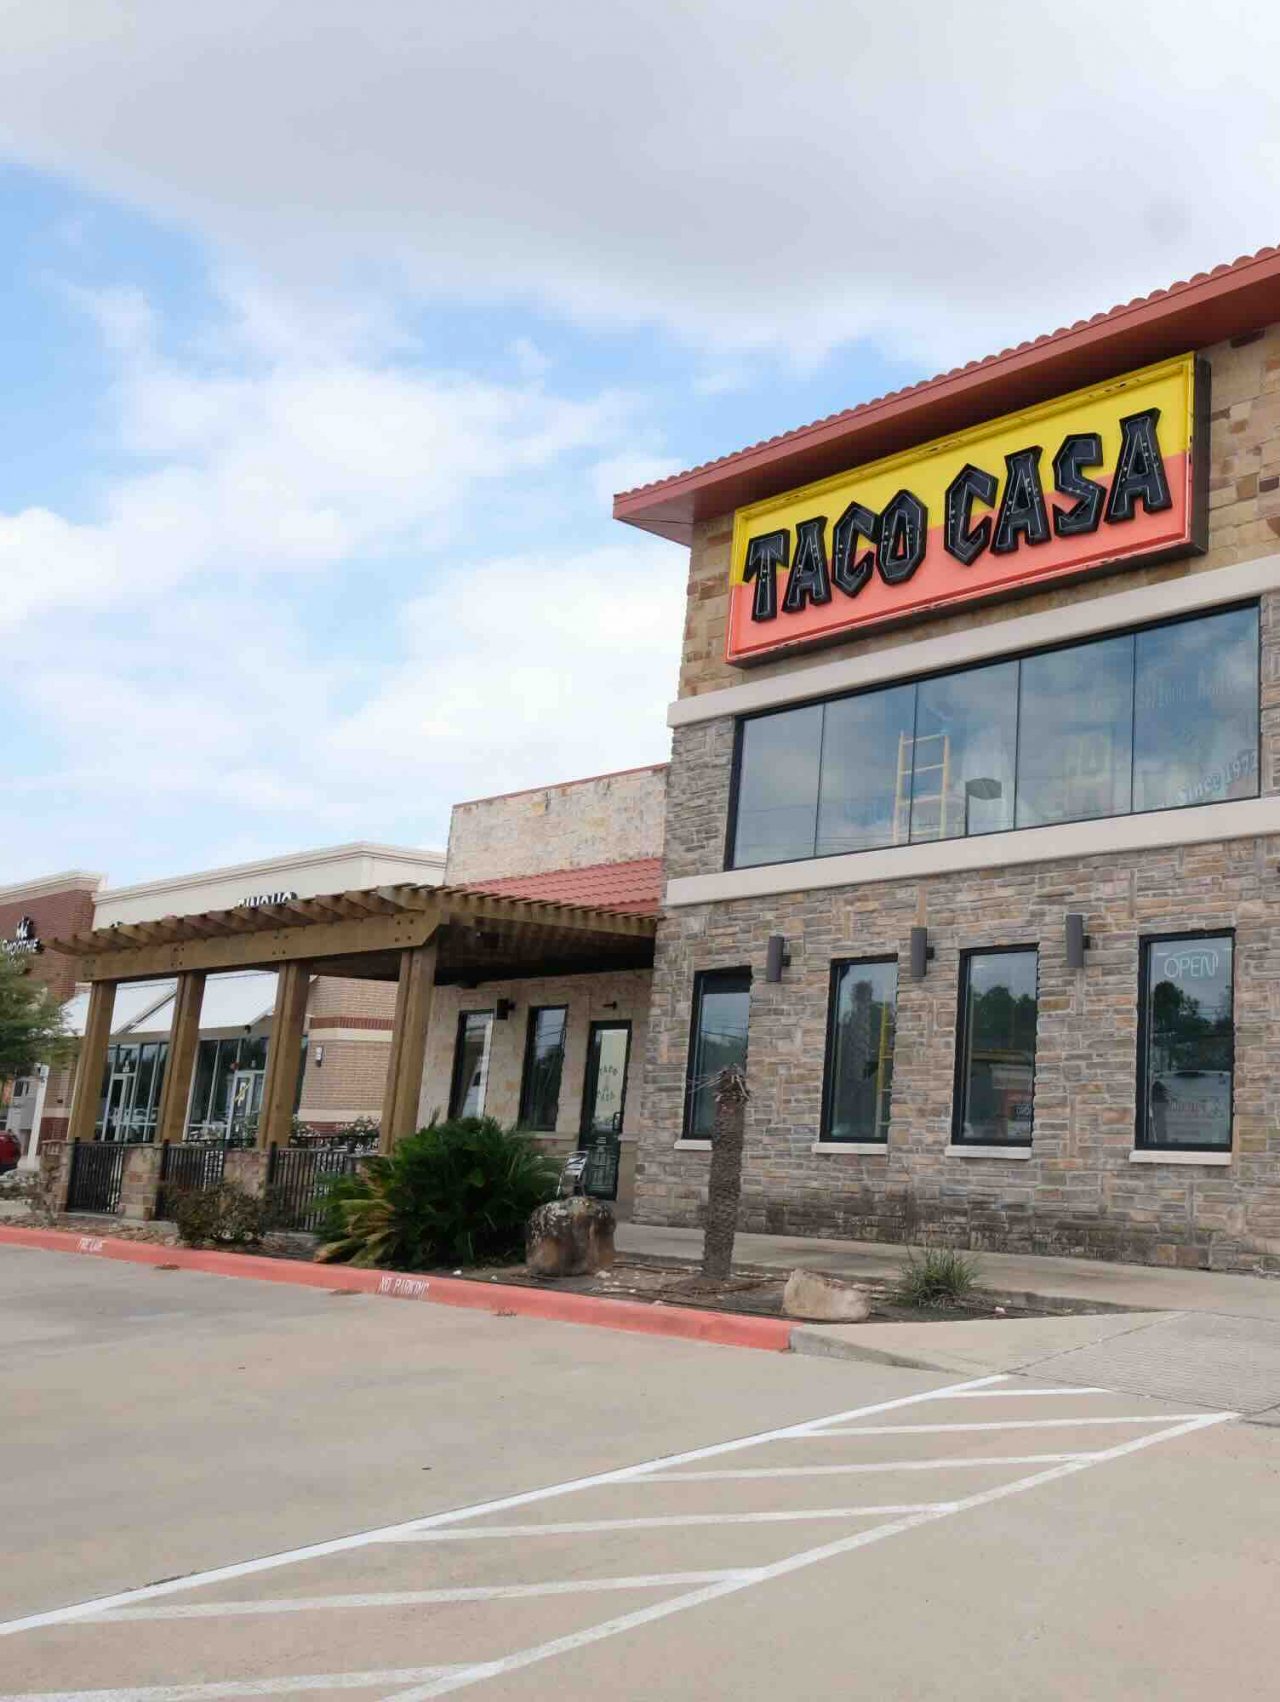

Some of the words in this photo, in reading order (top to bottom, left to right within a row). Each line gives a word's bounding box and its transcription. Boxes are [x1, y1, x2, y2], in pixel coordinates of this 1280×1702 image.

[742, 489, 929, 622] TACO
[943, 407, 1173, 566] CASA
[1164, 955, 1216, 978] OPEN
[377, 1276, 391, 1293] NO
